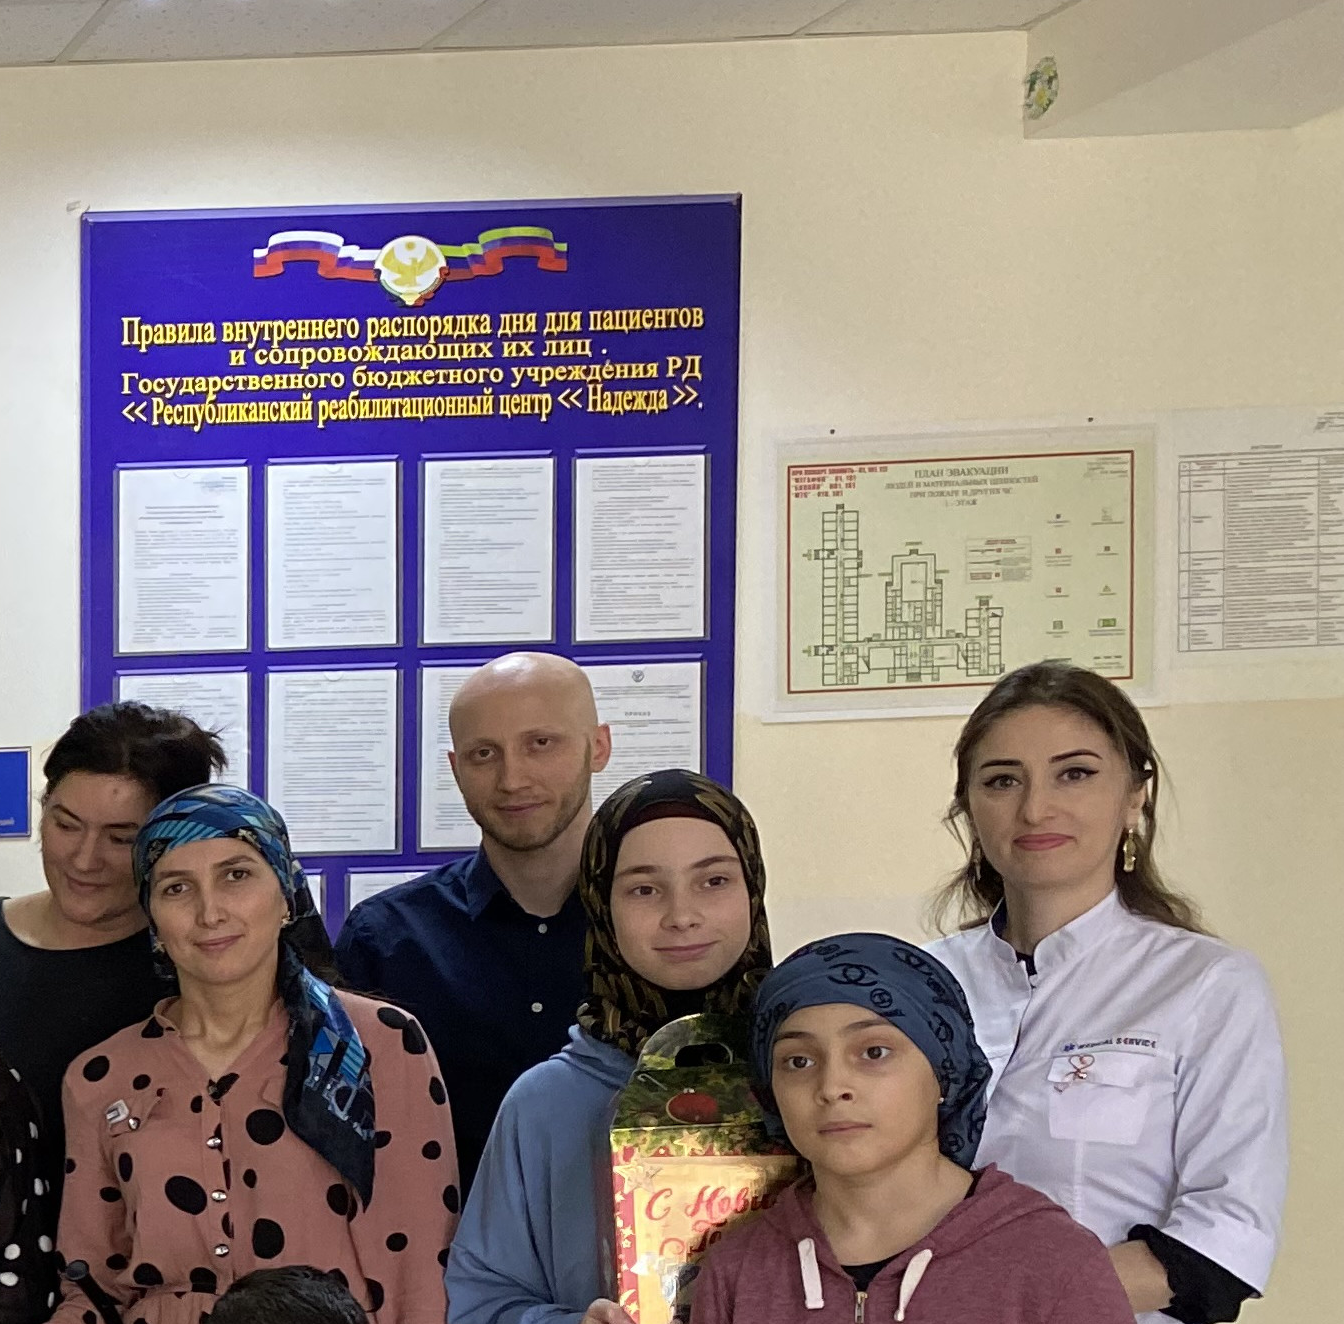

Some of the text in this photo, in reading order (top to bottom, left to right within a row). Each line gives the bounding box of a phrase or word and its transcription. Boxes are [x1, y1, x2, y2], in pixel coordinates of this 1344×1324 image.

[121, 307, 704, 352] Правила внутреннего распорядка дня для пациентов
[121, 355, 702, 398] Государственного бюджетного учреждения РД
[229, 349, 245, 366] и
[254, 341, 493, 369] сопровождающих
[502, 340, 534, 358] их
[151, 393, 313, 432] Республиканский
[317, 388, 494, 428] реабилитационный
[499, 393, 552, 422] центр
[586, 383, 668, 417] Надежда
